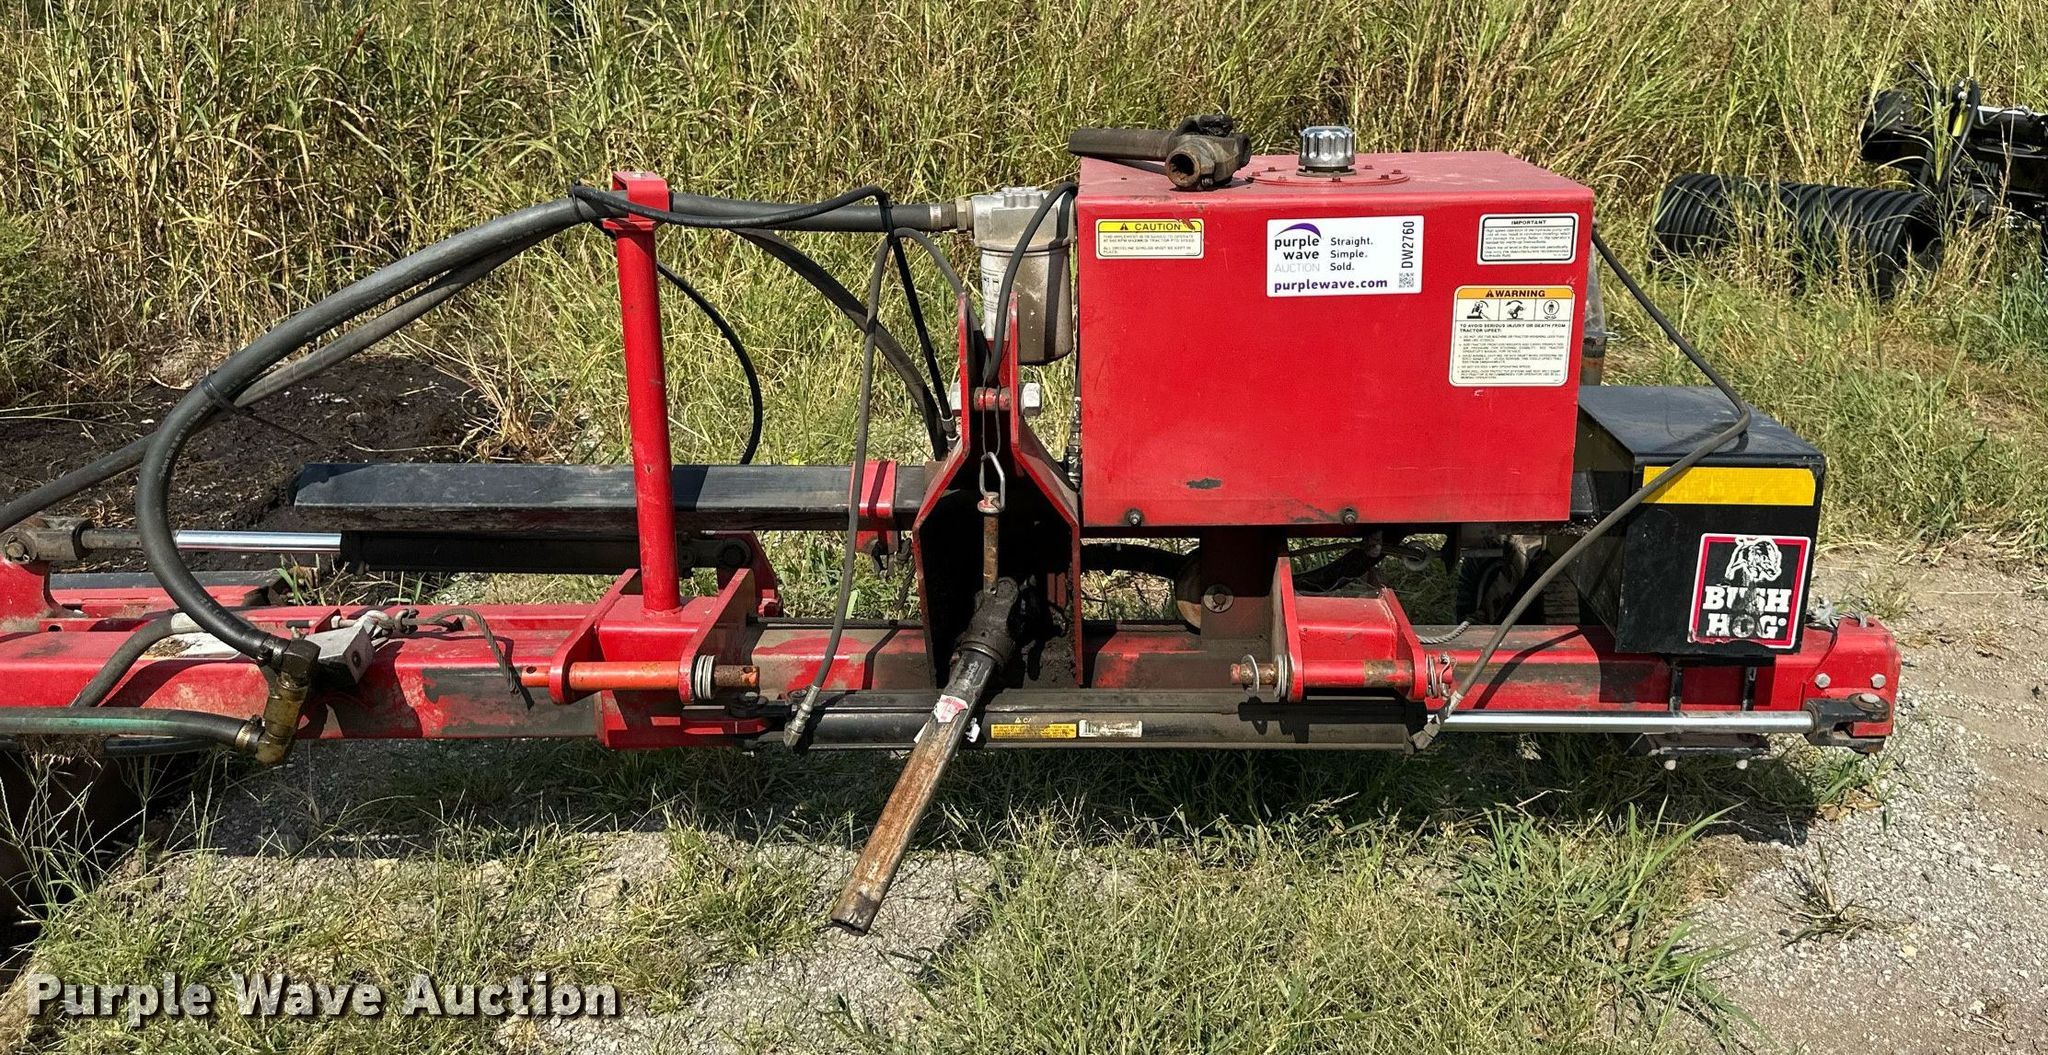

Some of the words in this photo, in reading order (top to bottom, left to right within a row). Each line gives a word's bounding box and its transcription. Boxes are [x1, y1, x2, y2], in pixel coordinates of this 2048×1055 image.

[1134, 223, 1181, 231] CAUTION
[1274, 235, 1320, 250] purple
[1330, 236, 1373, 248] Straight.
[1401, 221, 1415, 269] DW2760
[1283, 250, 1320, 260] wave
[1330, 249, 1368, 260] Simple.
[1274, 262, 1320, 273] AUCTION
[1330, 262, 1355, 271] Sold.
[1274, 279, 1388, 293] purplewave.com
[1702, 585, 1792, 614] BUSH
